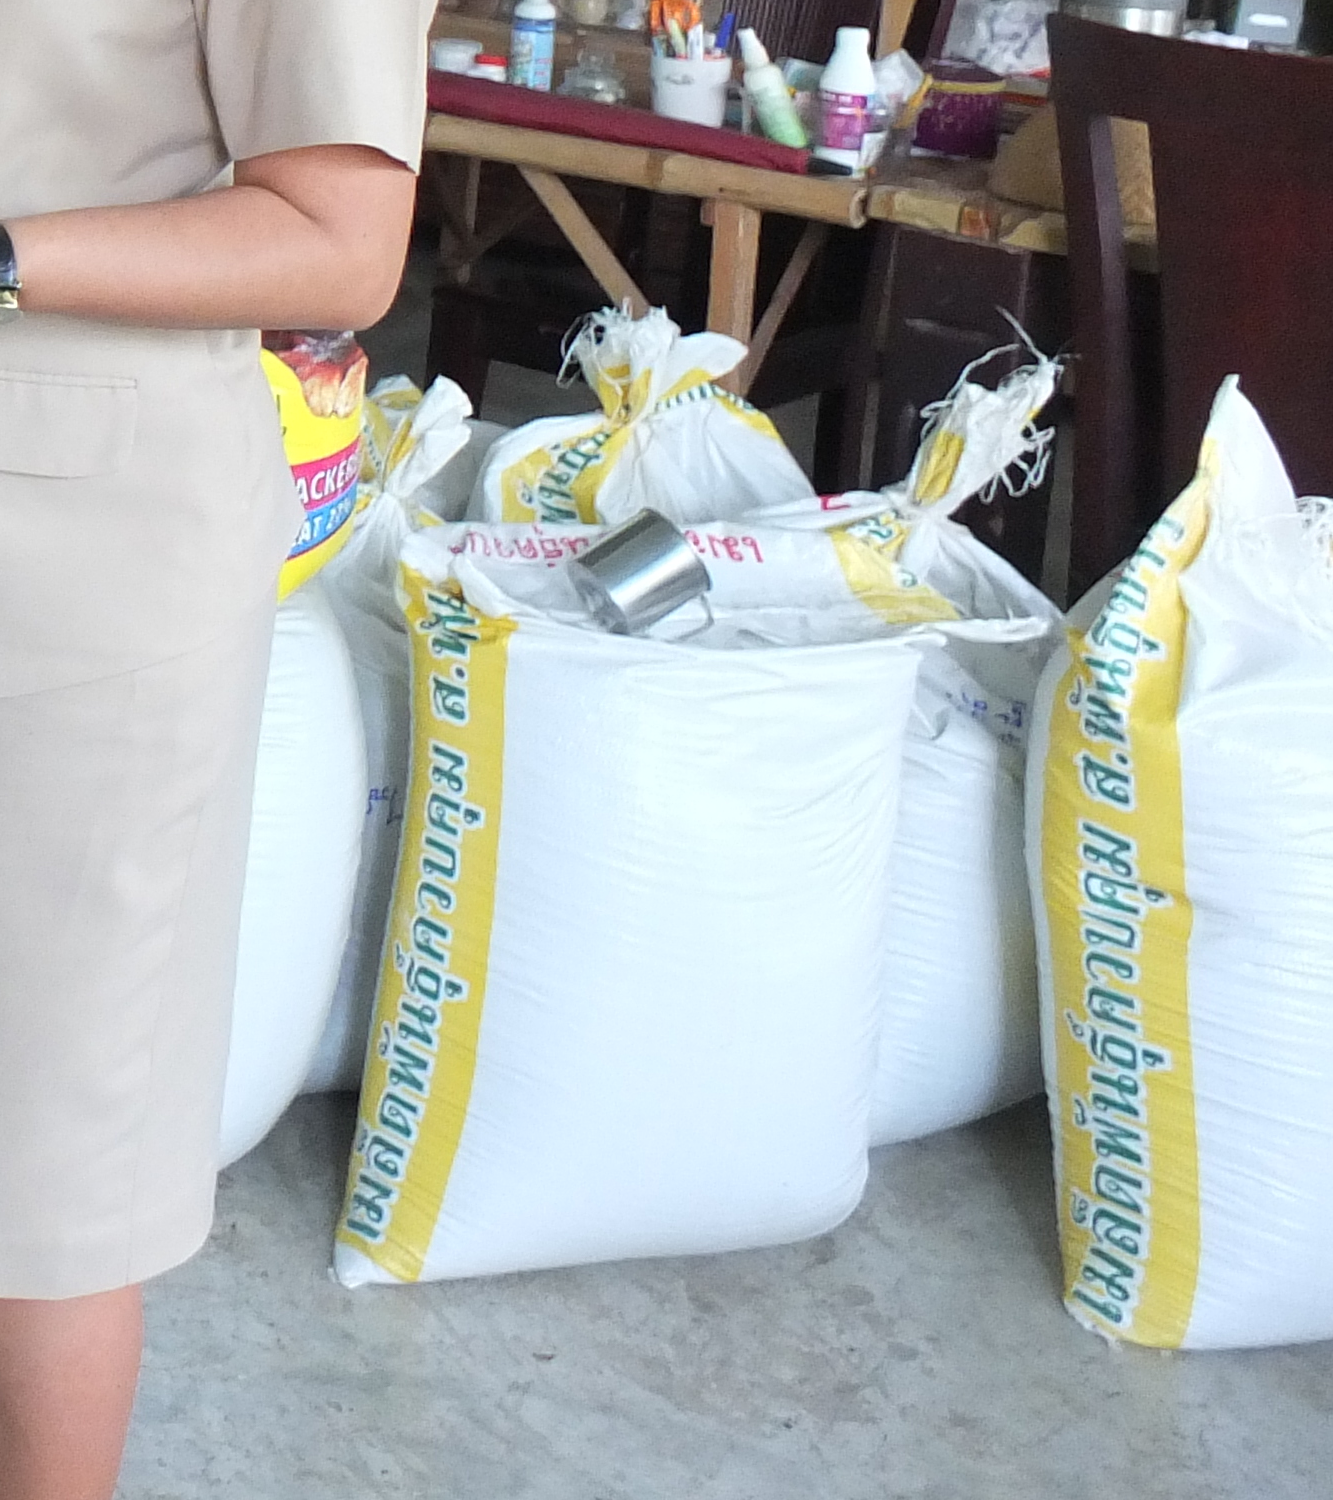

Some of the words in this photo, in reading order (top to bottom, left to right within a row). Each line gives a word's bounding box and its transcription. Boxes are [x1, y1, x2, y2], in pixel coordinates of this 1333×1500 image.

[345, 744, 484, 1241] เมล็ดพันธุ์ควบคุม
[1068, 826, 1164, 1330] เมล็ดพันธุ์ควบคุม
